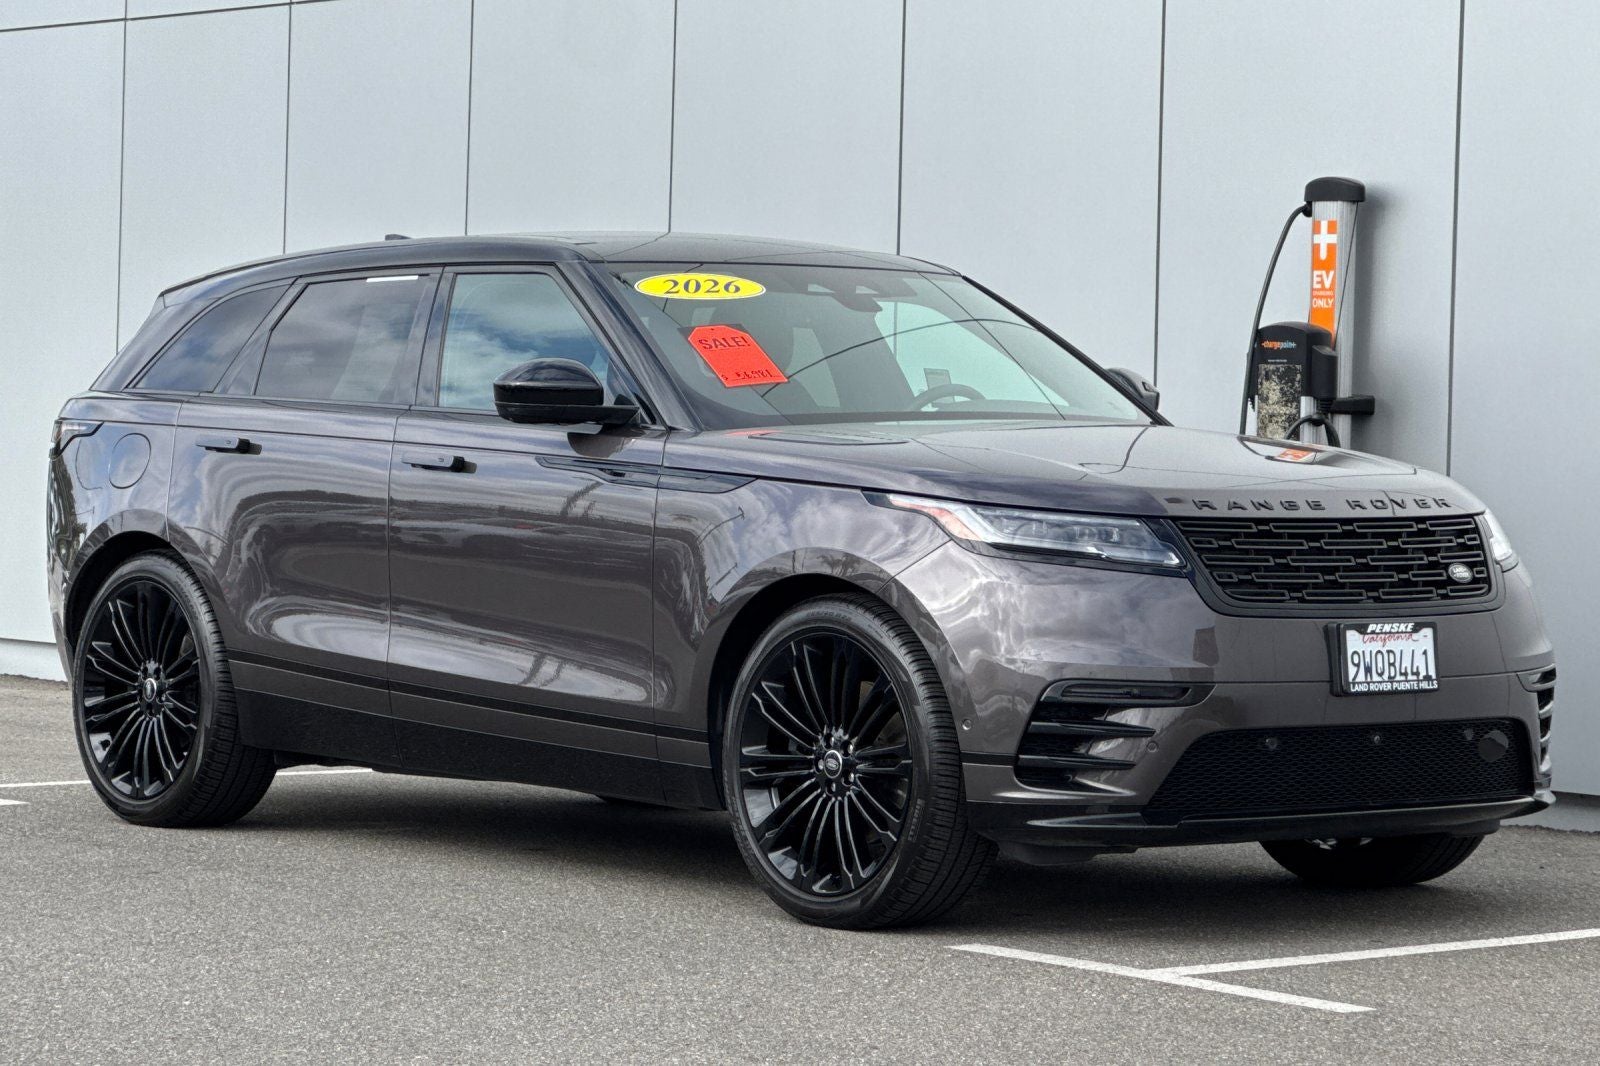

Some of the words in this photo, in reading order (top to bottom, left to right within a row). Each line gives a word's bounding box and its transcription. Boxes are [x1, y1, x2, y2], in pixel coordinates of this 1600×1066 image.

[1312, 270, 1335, 289] EV
[663, 279, 741, 295] 2026
[1312, 298, 1334, 308] ONLY
[699, 335, 751, 350] SALE!
[1192, 499, 1326, 511] RANGE
[1346, 497, 1452, 510] ROVER
[1367, 622, 1415, 633] PENSKE
[1351, 649, 1434, 681] 9WQB441
[1350, 683, 1369, 692] LAND
[1369, 682, 1392, 692] ROVER
[1393, 681, 1419, 690] PUENTE
[1419, 680, 1438, 689] HILLS
